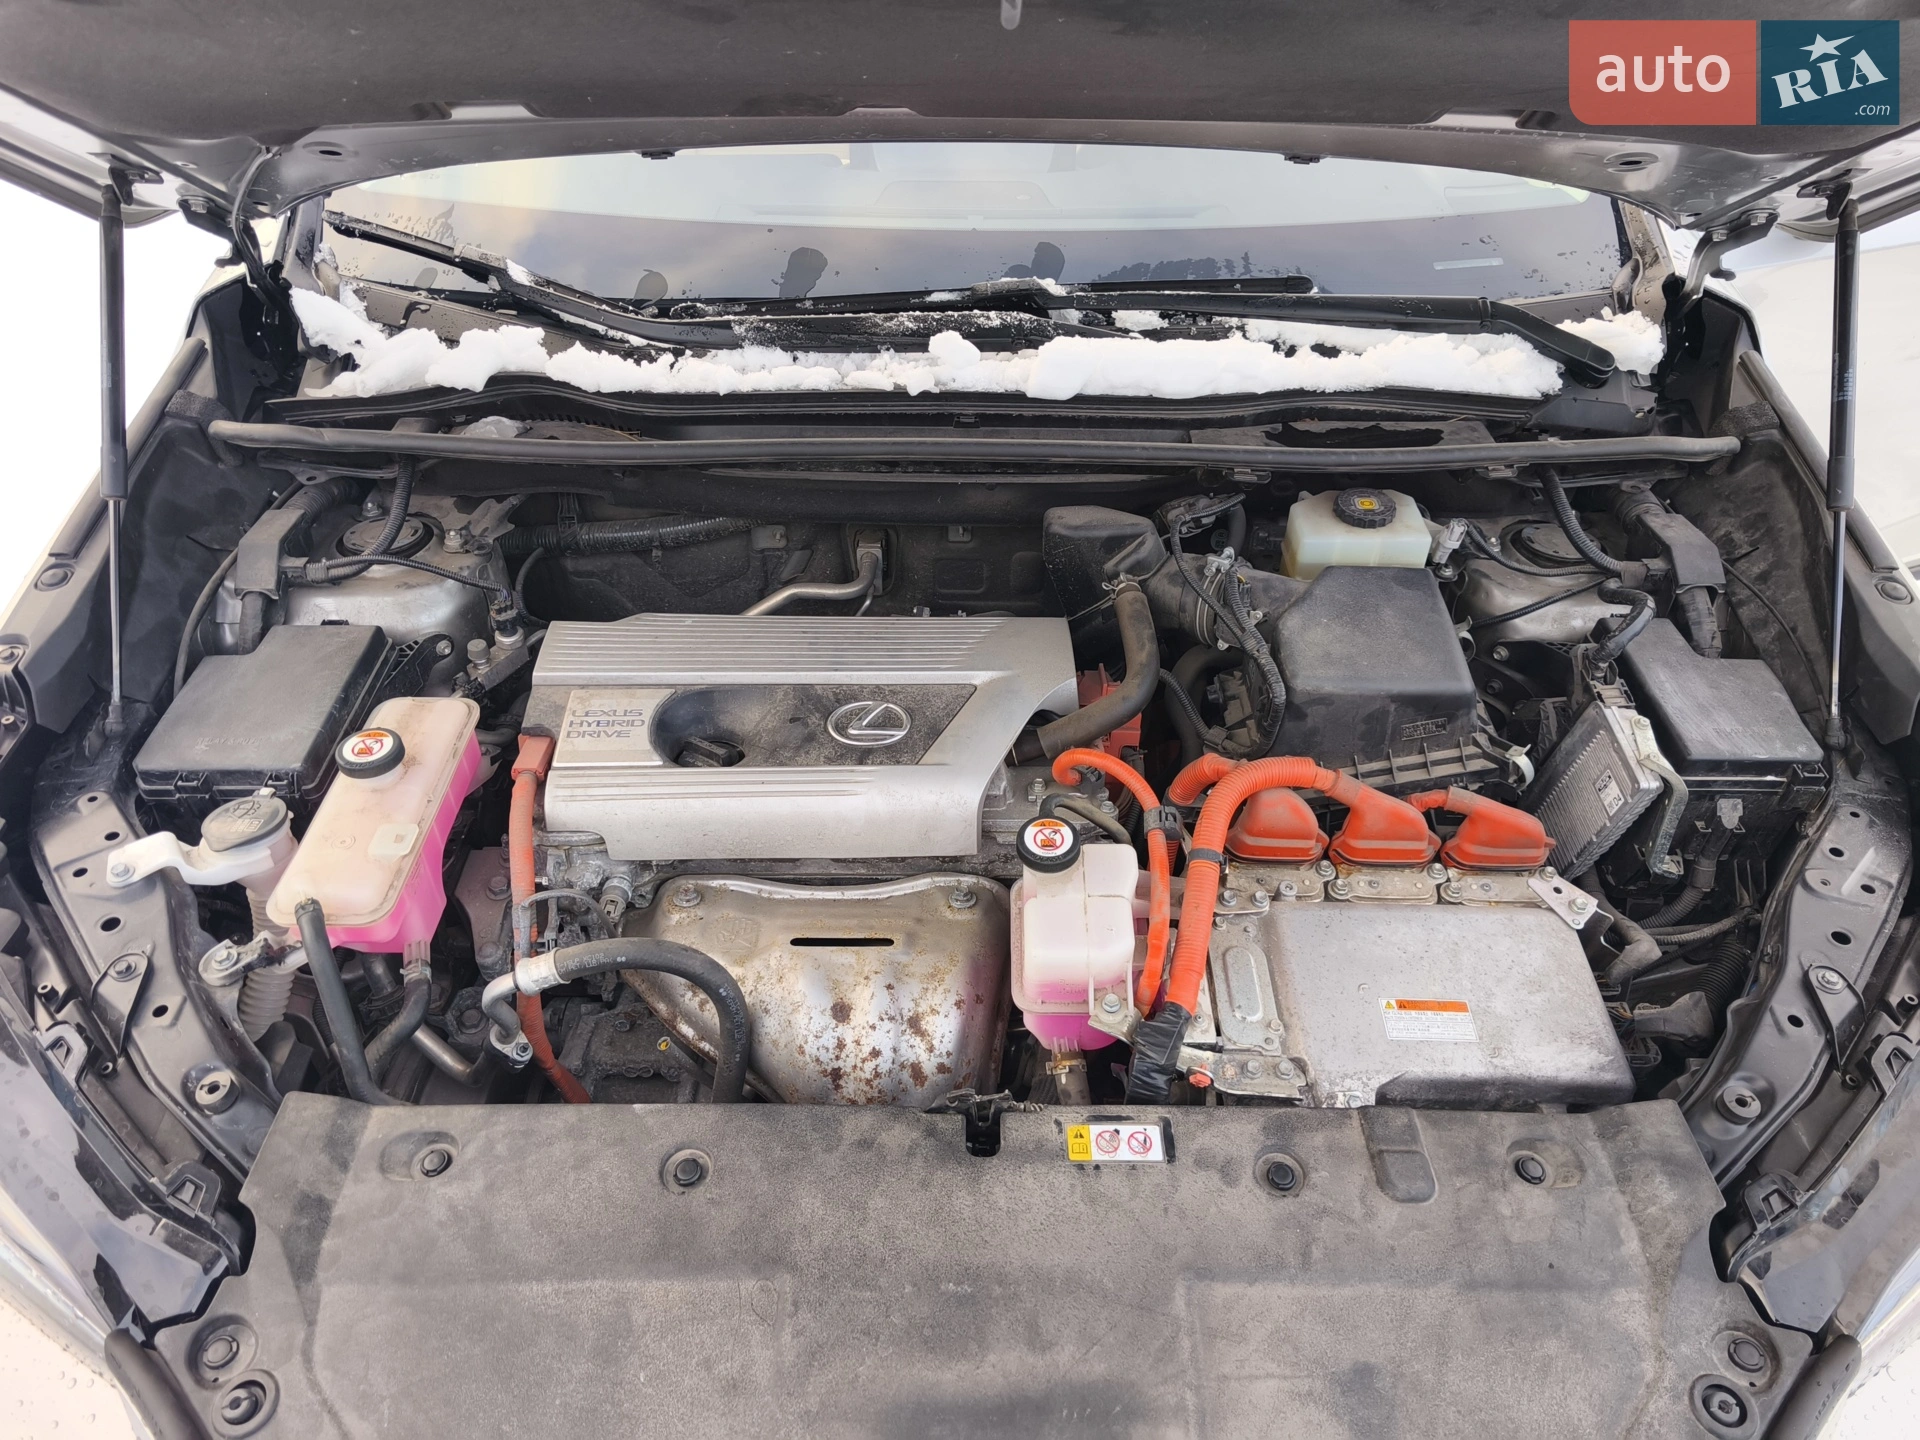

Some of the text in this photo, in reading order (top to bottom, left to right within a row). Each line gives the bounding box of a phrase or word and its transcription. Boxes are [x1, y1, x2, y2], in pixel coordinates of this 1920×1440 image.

[572, 709, 644, 718] LEXUS
[569, 719, 646, 728] HYBRID
[566, 730, 632, 739] DRIVE
